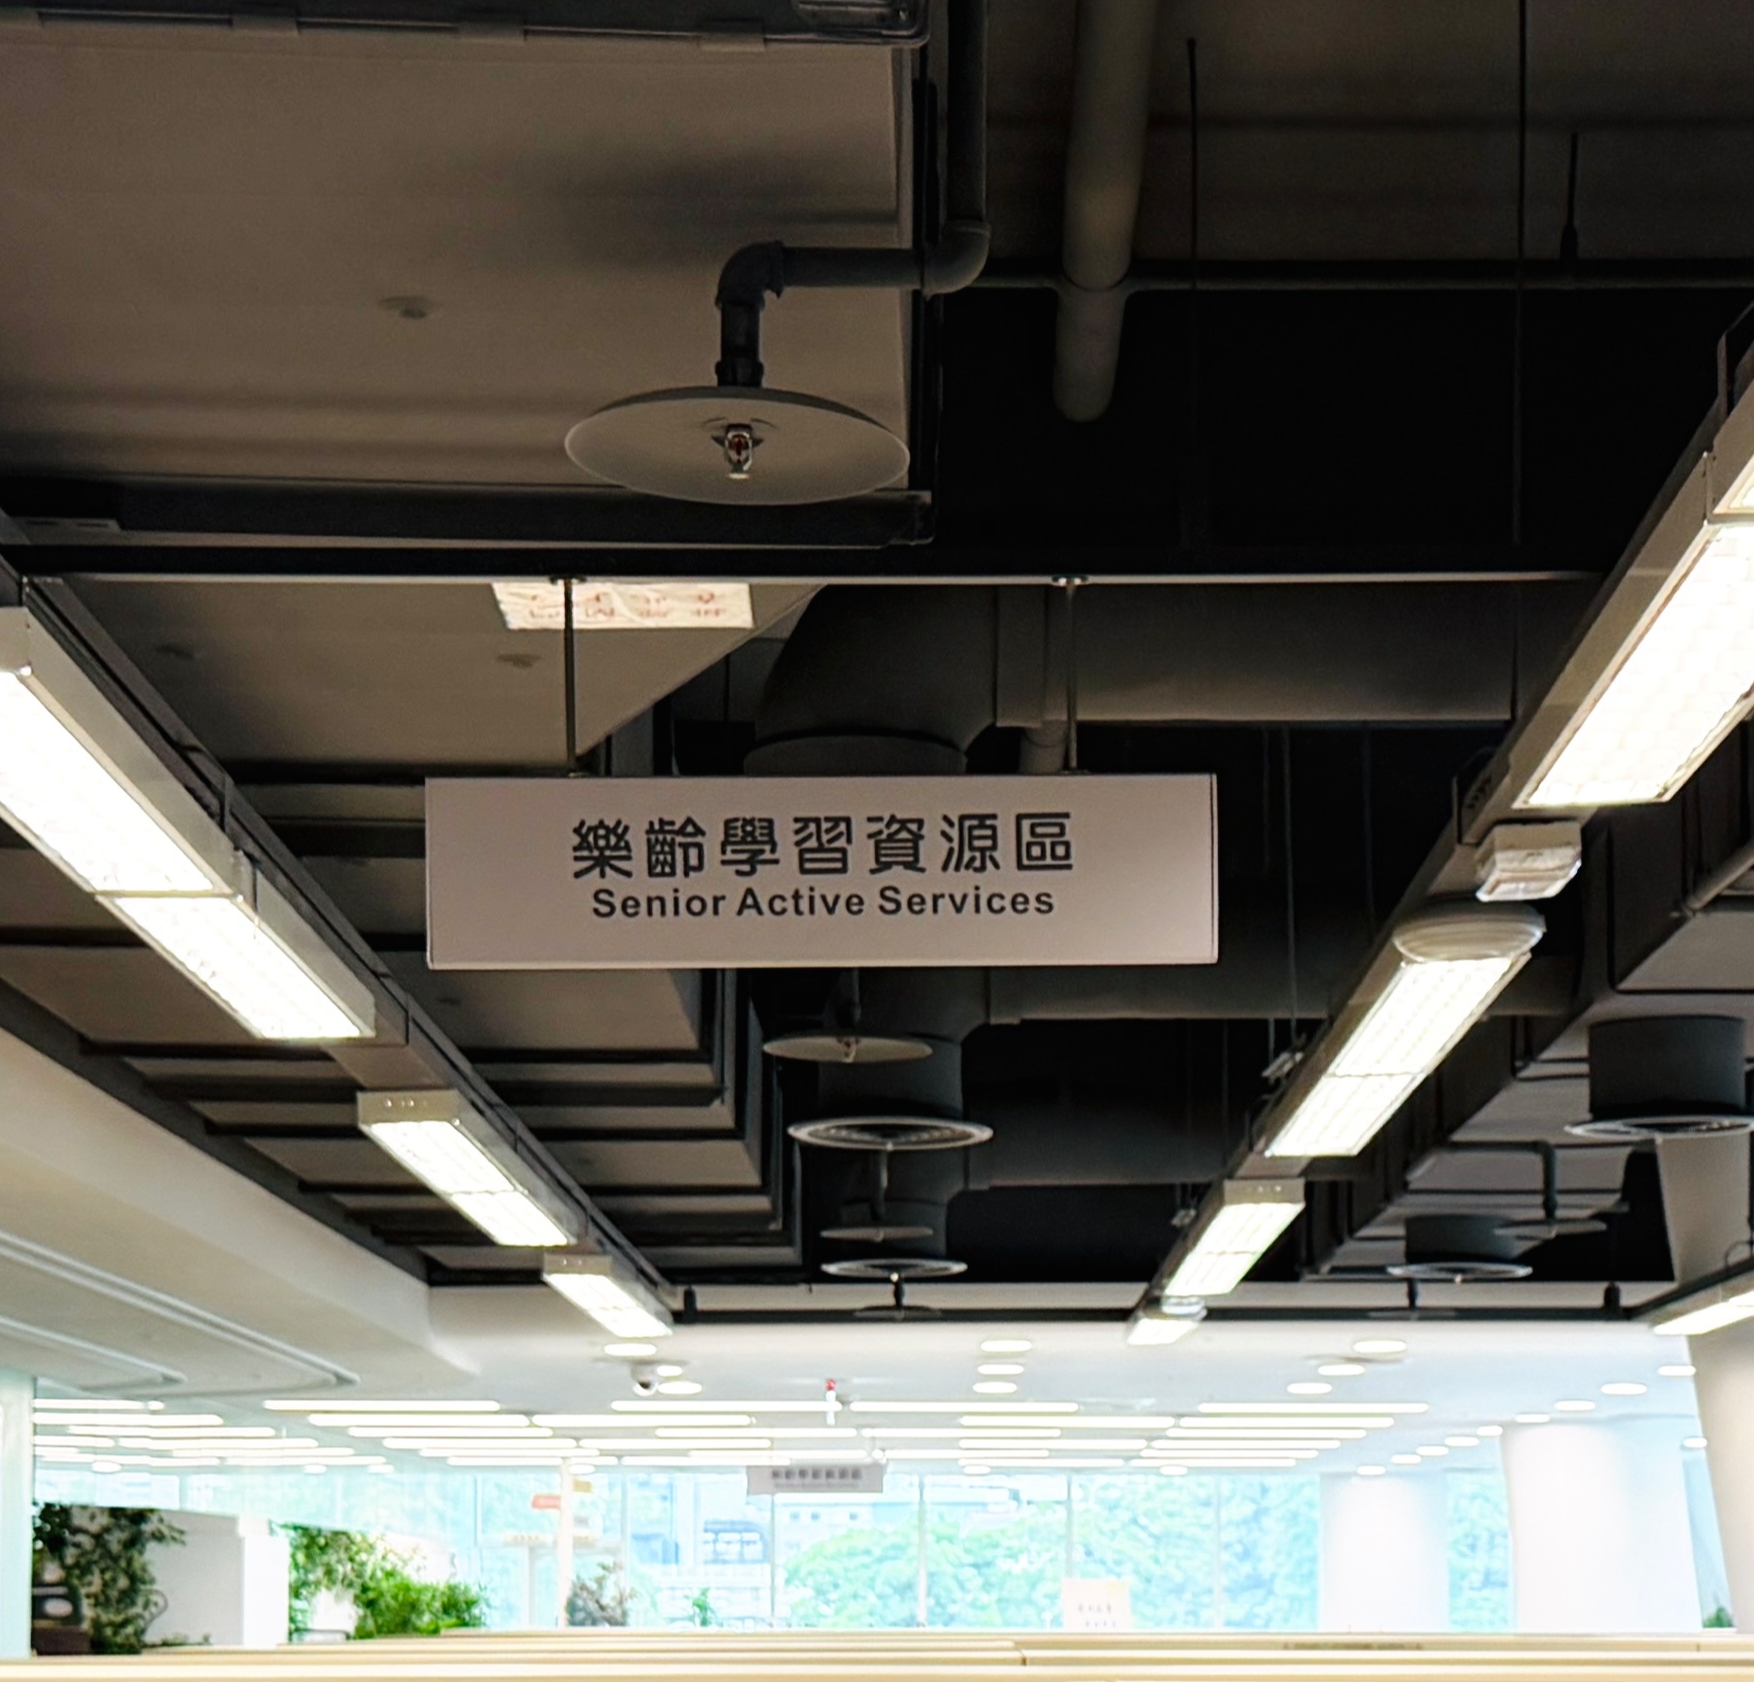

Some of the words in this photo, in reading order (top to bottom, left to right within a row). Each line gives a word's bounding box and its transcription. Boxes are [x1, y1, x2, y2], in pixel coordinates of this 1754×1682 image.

[570, 810, 1075, 878] 樂齡學習資源區
[591, 885, 726, 919] Senior
[736, 884, 865, 917] Active
[878, 882, 1055, 916] Services
